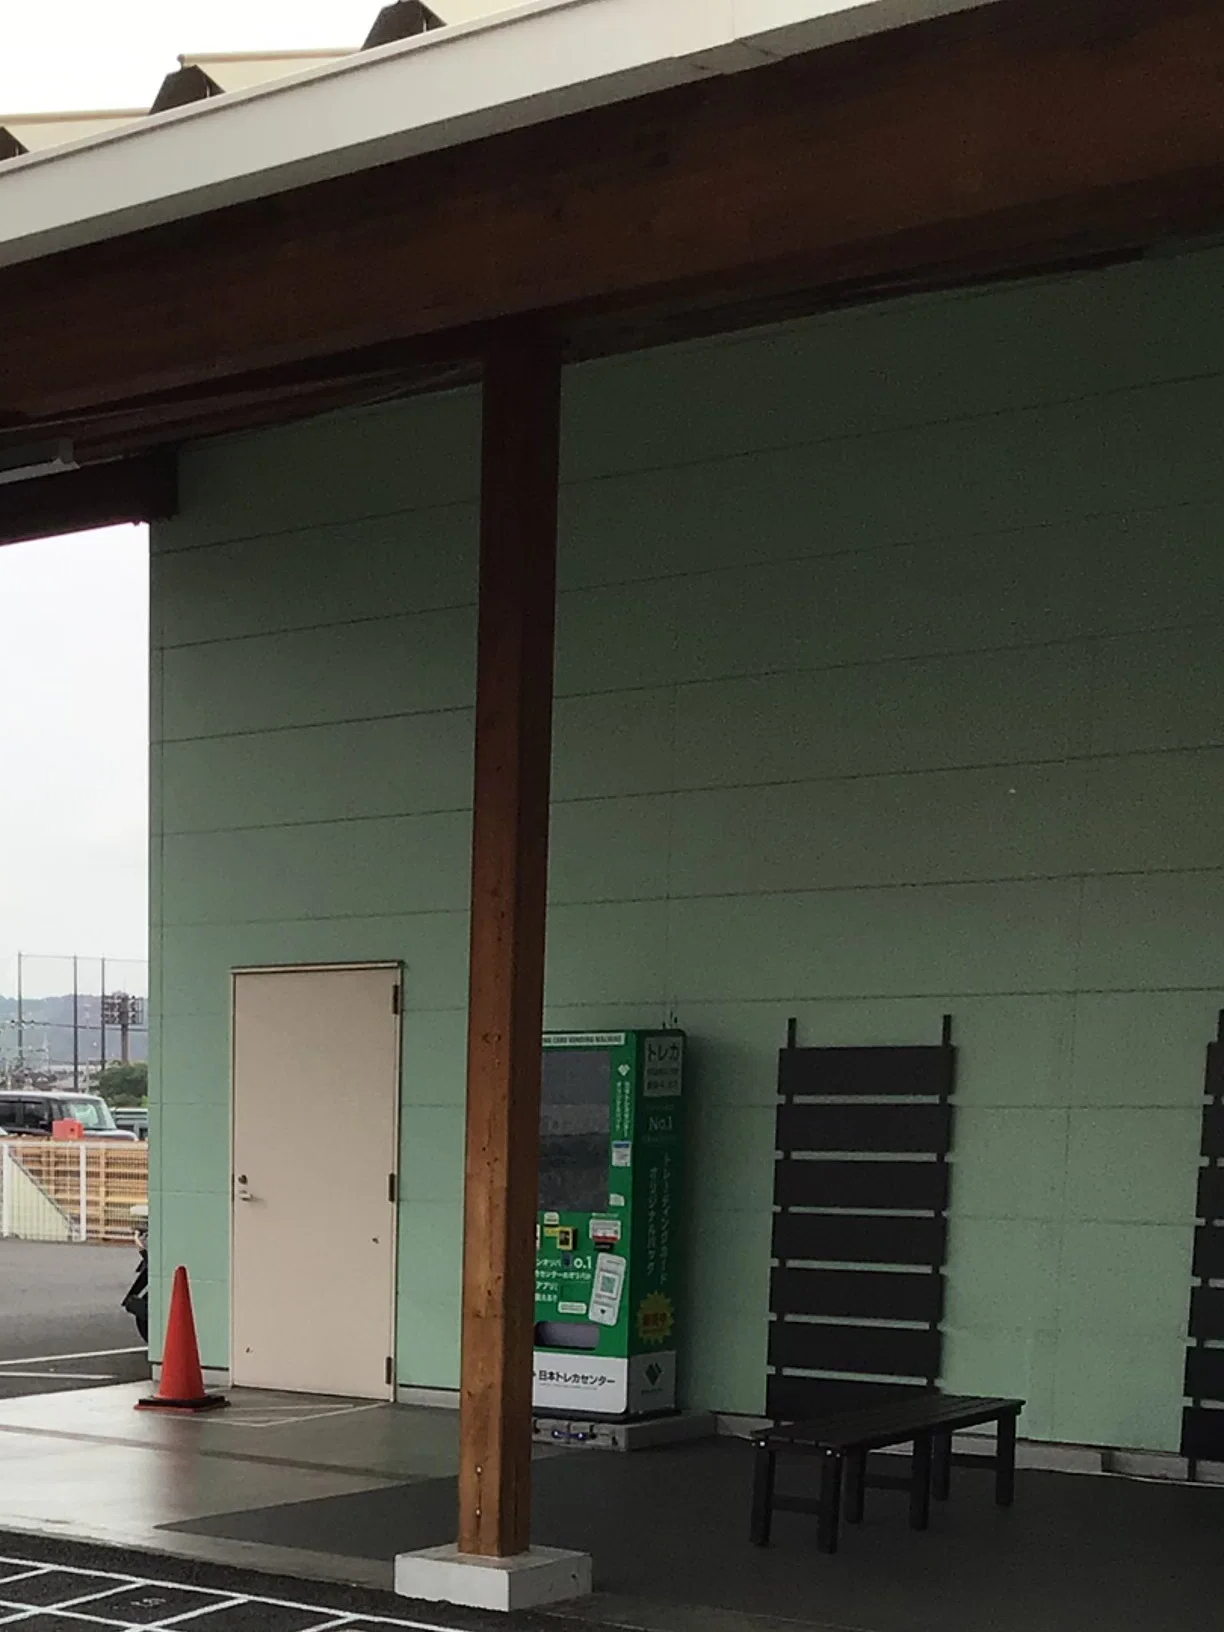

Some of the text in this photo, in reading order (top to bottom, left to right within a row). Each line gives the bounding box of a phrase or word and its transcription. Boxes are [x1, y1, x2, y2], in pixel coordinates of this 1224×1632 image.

[647, 1043, 680, 1063] トレカ
[538, 1370, 616, 1386] 日本トレカセンター
